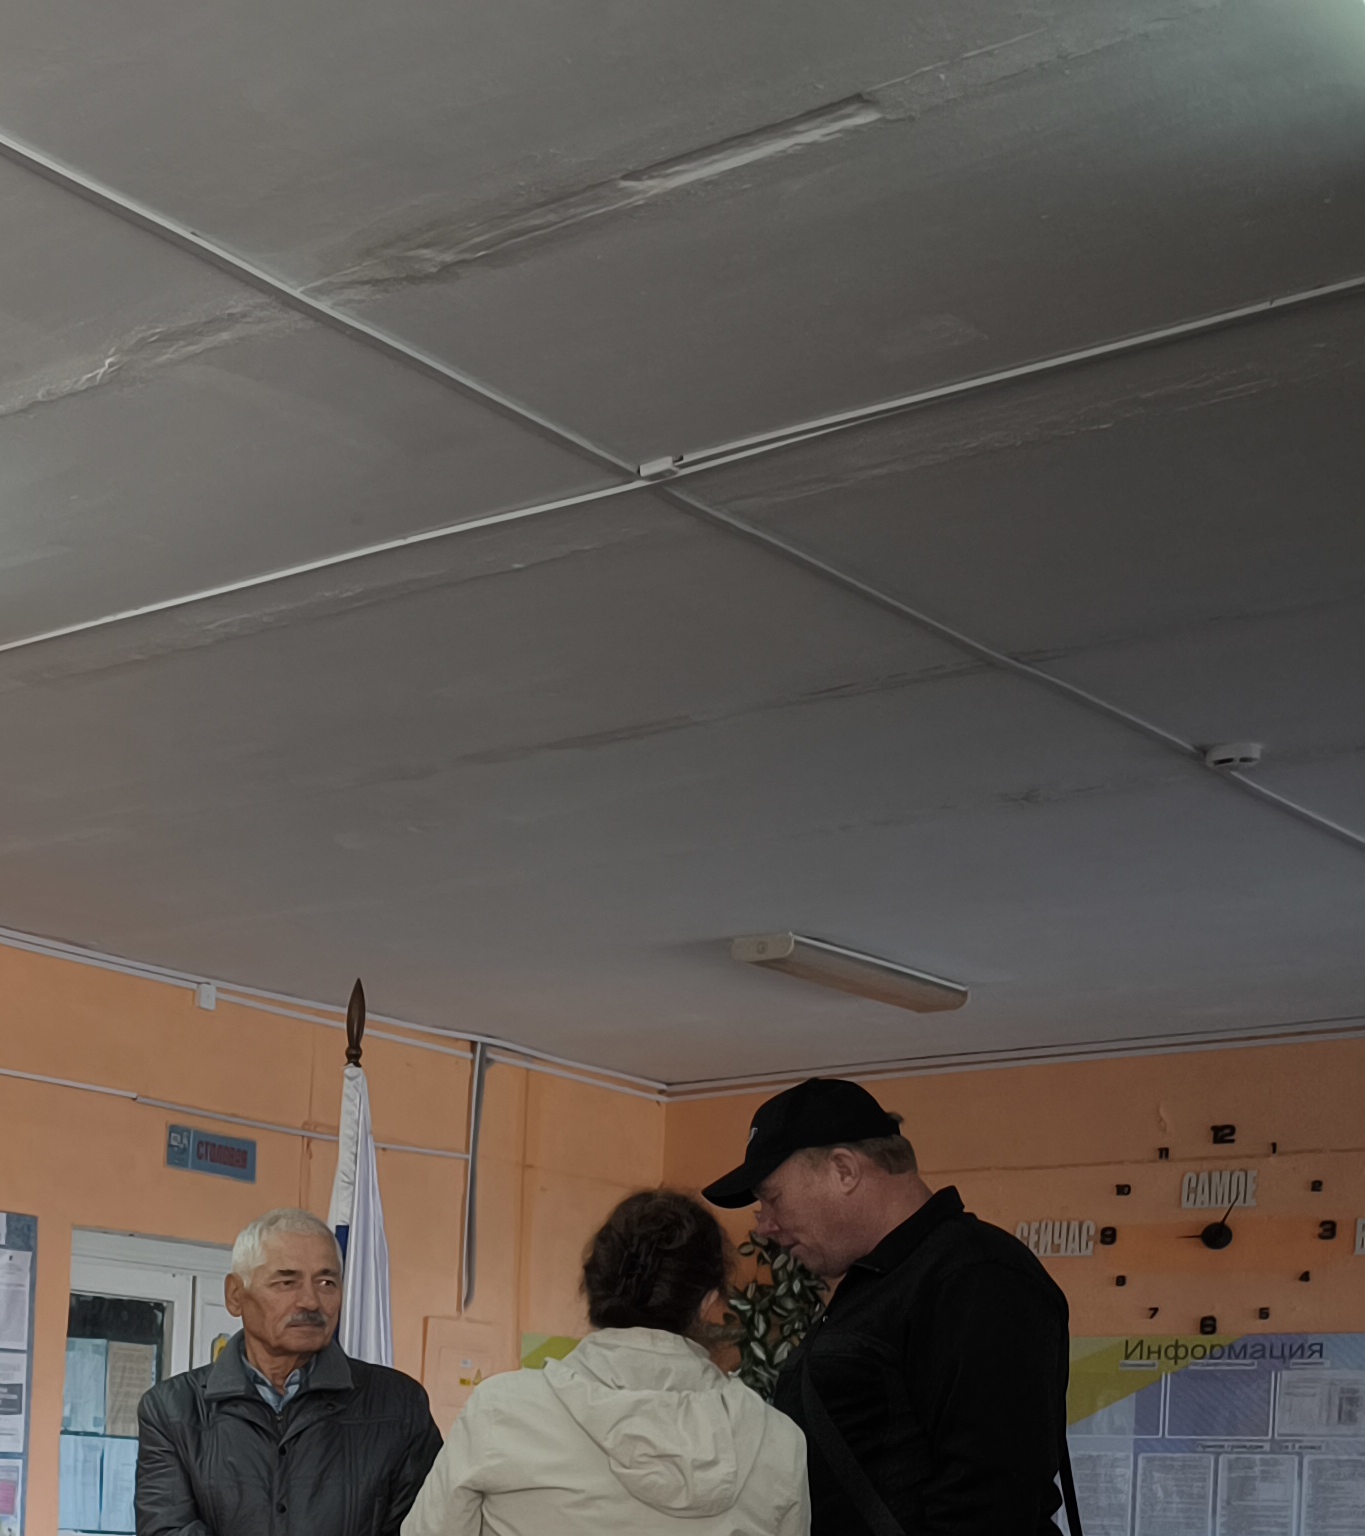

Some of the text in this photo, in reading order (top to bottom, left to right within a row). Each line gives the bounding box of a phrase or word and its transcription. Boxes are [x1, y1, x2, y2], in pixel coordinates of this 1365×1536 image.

[1210, 1124, 1236, 1144] 12
[1271, 1142, 1277, 1154] 1
[1115, 1184, 1131, 1196] 10
[1181, 1170, 1258, 1209] САМОЕ
[1311, 1180, 1323, 1192] 2
[1100, 1226, 1117, 1246] 9
[1318, 1220, 1337, 1240] 3
[1299, 1271, 1311, 1282] 4
[1148, 1307, 1159, 1319] 7
[1258, 1307, 1270, 1320] 5
[1200, 1316, 1217, 1335] 6
[1124, 1339, 1324, 1365] Информация
